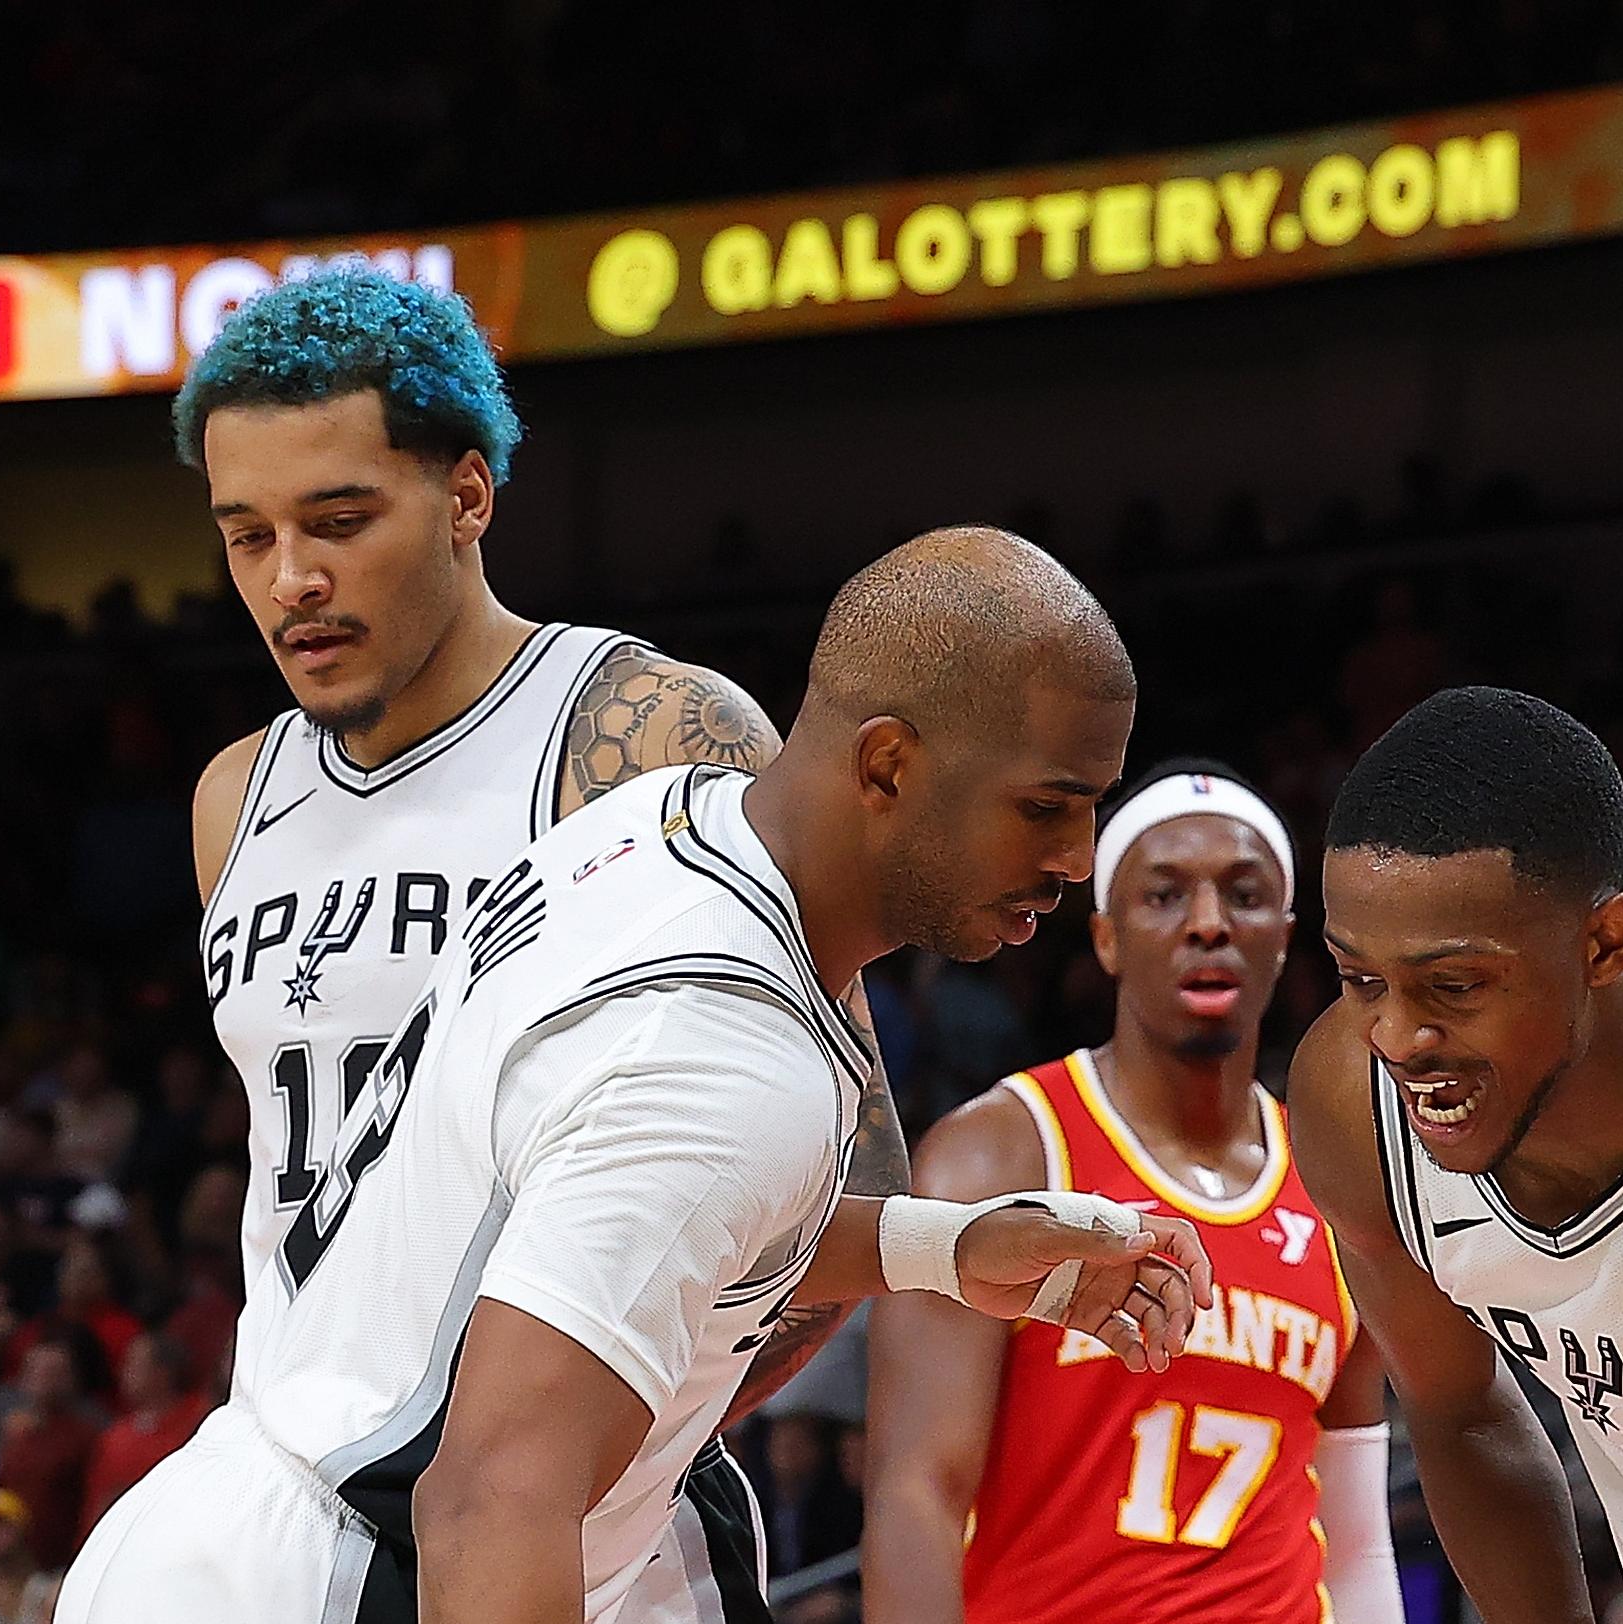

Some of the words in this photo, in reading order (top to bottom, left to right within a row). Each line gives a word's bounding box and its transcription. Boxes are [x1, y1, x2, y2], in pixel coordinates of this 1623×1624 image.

[587, 230, 679, 337] @
[701, 130, 1521, 316] GALOTTERY.COM
[79, 245, 456, 380] NO
[207, 872, 492, 1014] SPUR
[1056, 1284, 1339, 1404] ANTA
[1116, 1399, 1284, 1551] 17
